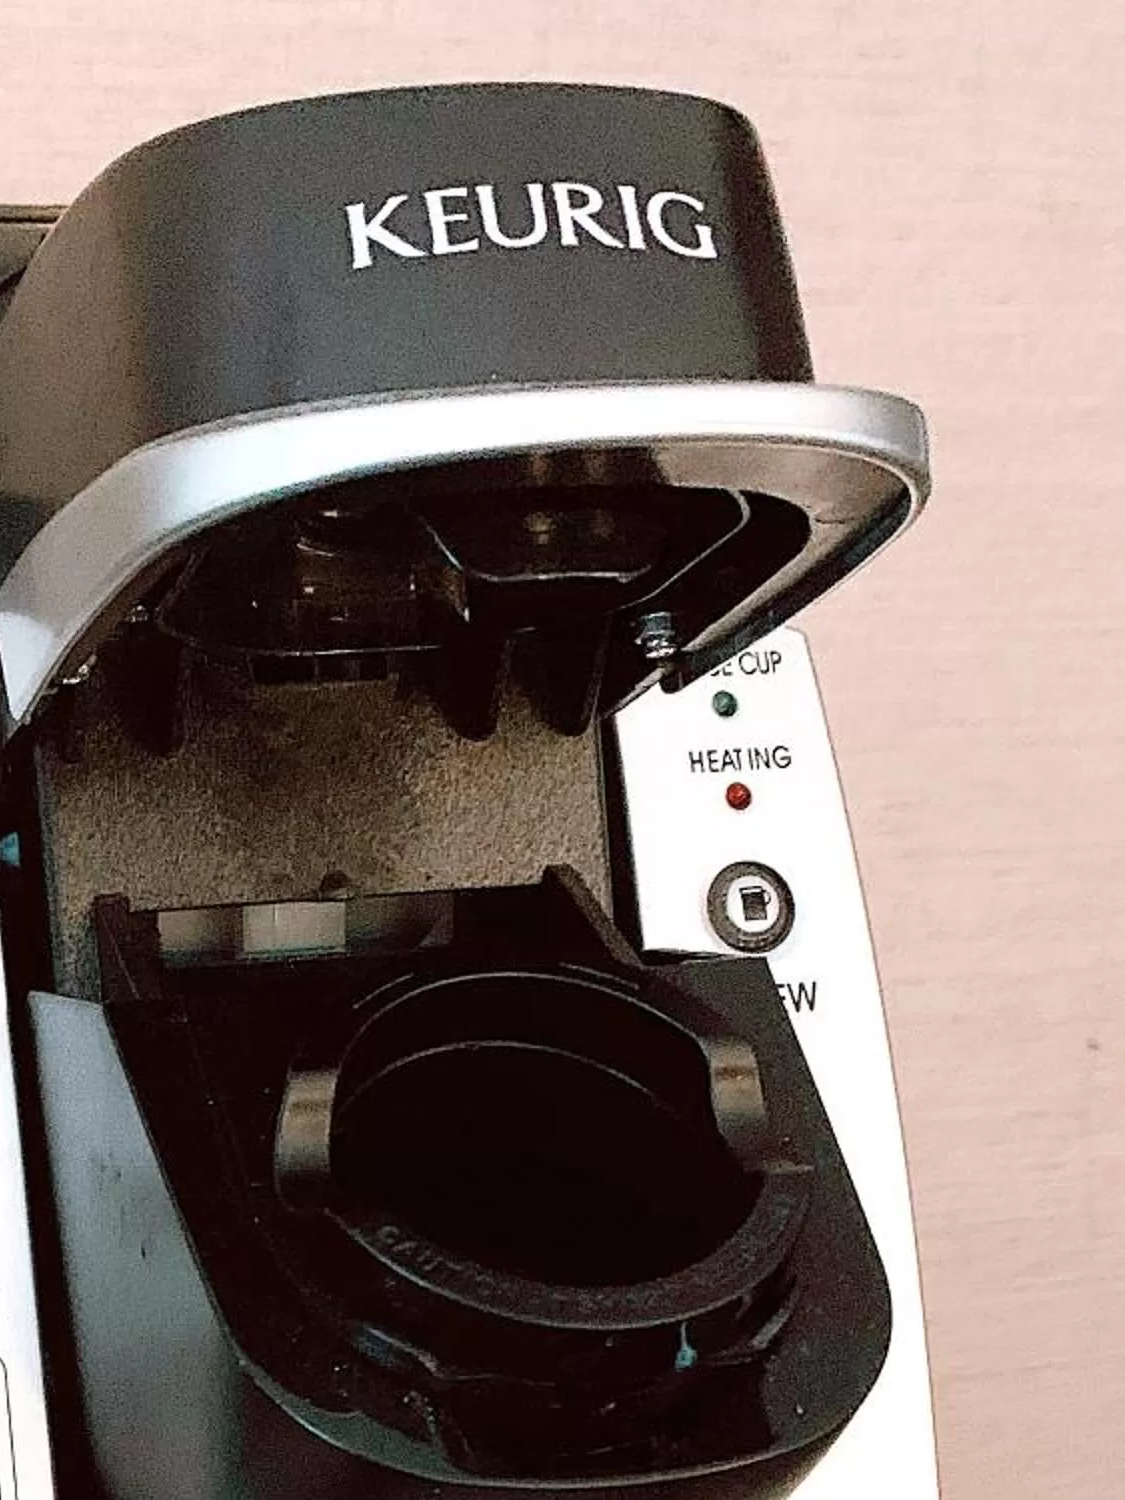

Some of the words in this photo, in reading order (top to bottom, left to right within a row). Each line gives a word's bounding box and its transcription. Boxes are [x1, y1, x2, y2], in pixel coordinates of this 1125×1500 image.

[345, 181, 718, 269] KEURIG
[738, 650, 782, 675] CUP
[688, 745, 793, 774] HEATING
